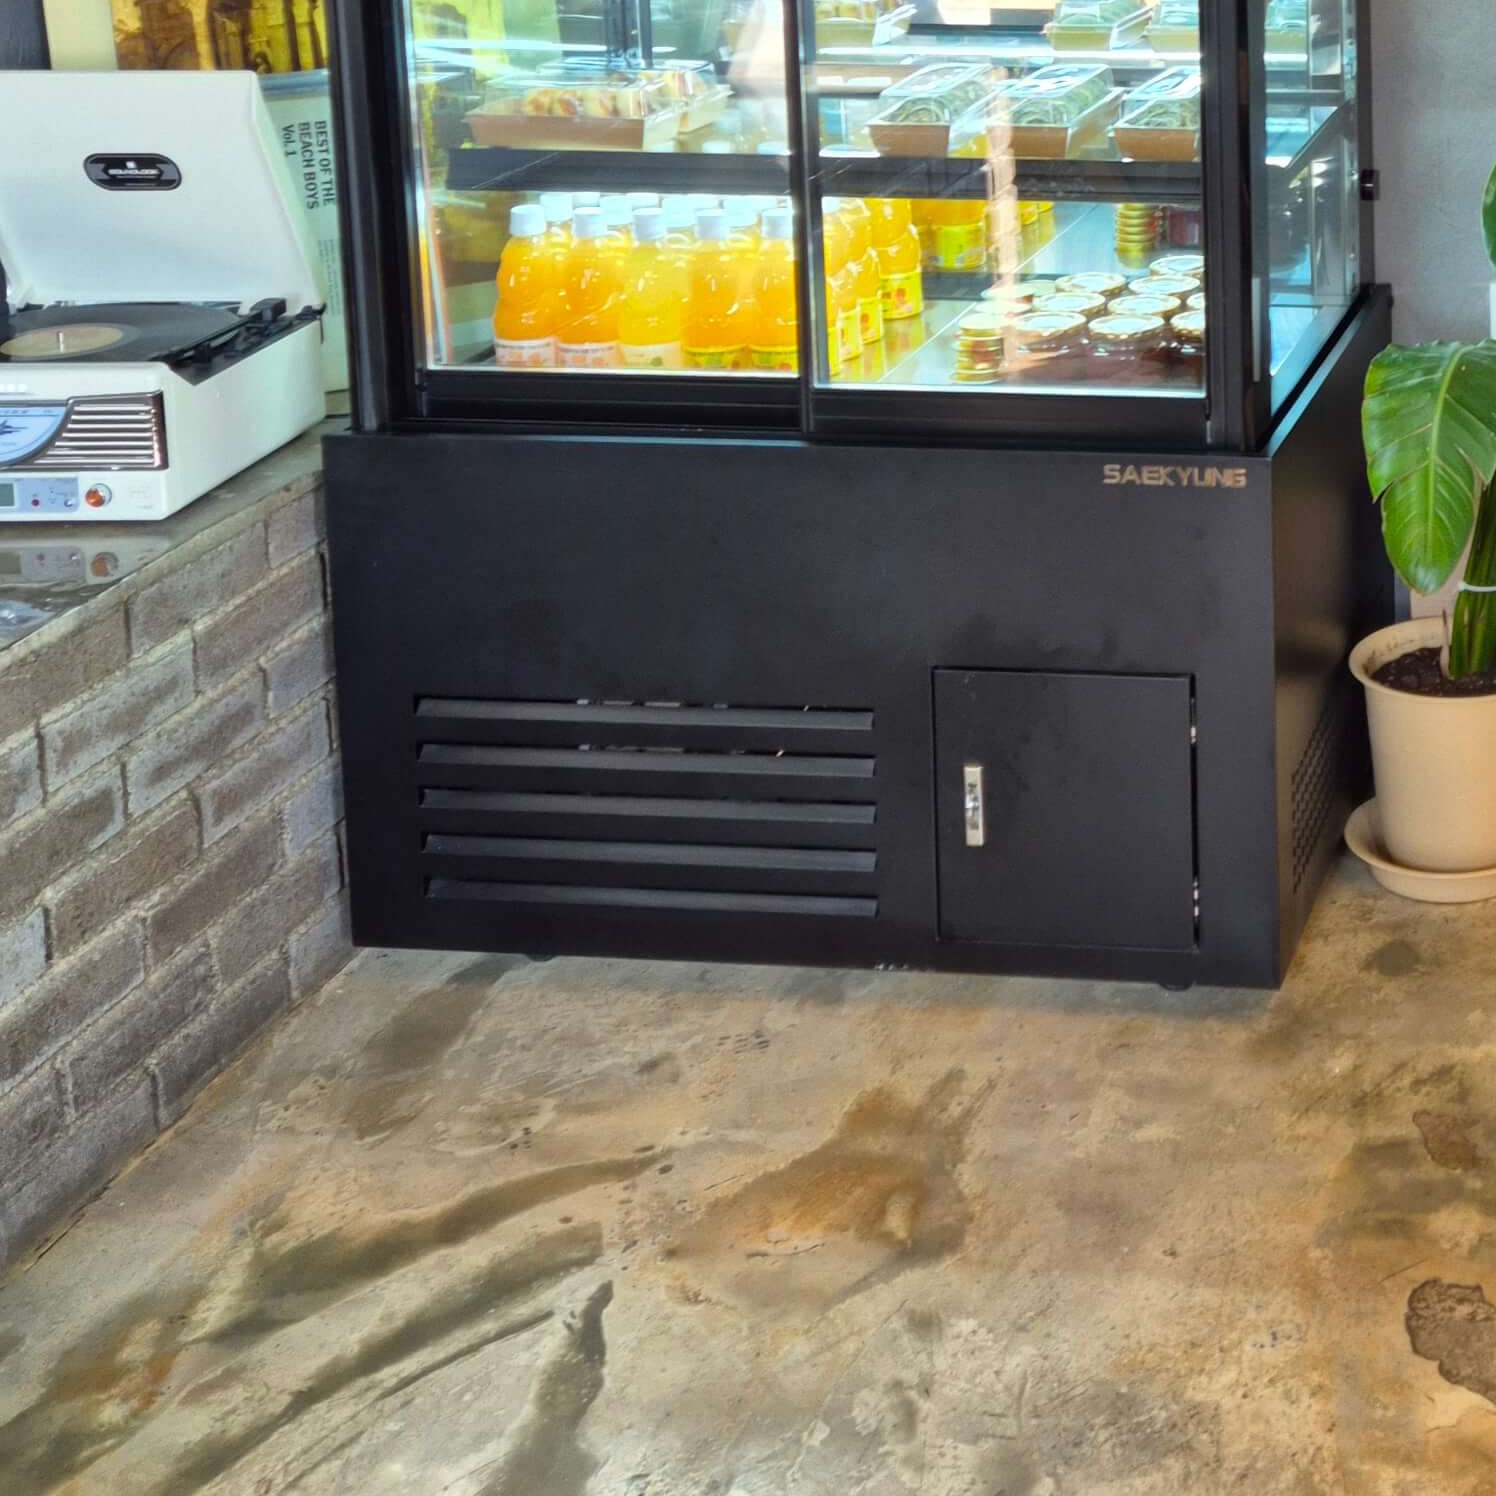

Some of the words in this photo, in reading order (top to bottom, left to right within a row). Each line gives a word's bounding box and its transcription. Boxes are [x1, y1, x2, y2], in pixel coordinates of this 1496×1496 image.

[298, 121, 316, 169] BEACH
[314, 120, 329, 154] BEST
[319, 155, 332, 177] OF
[303, 170, 320, 210] BOYS
[321, 177, 337, 207] THE
